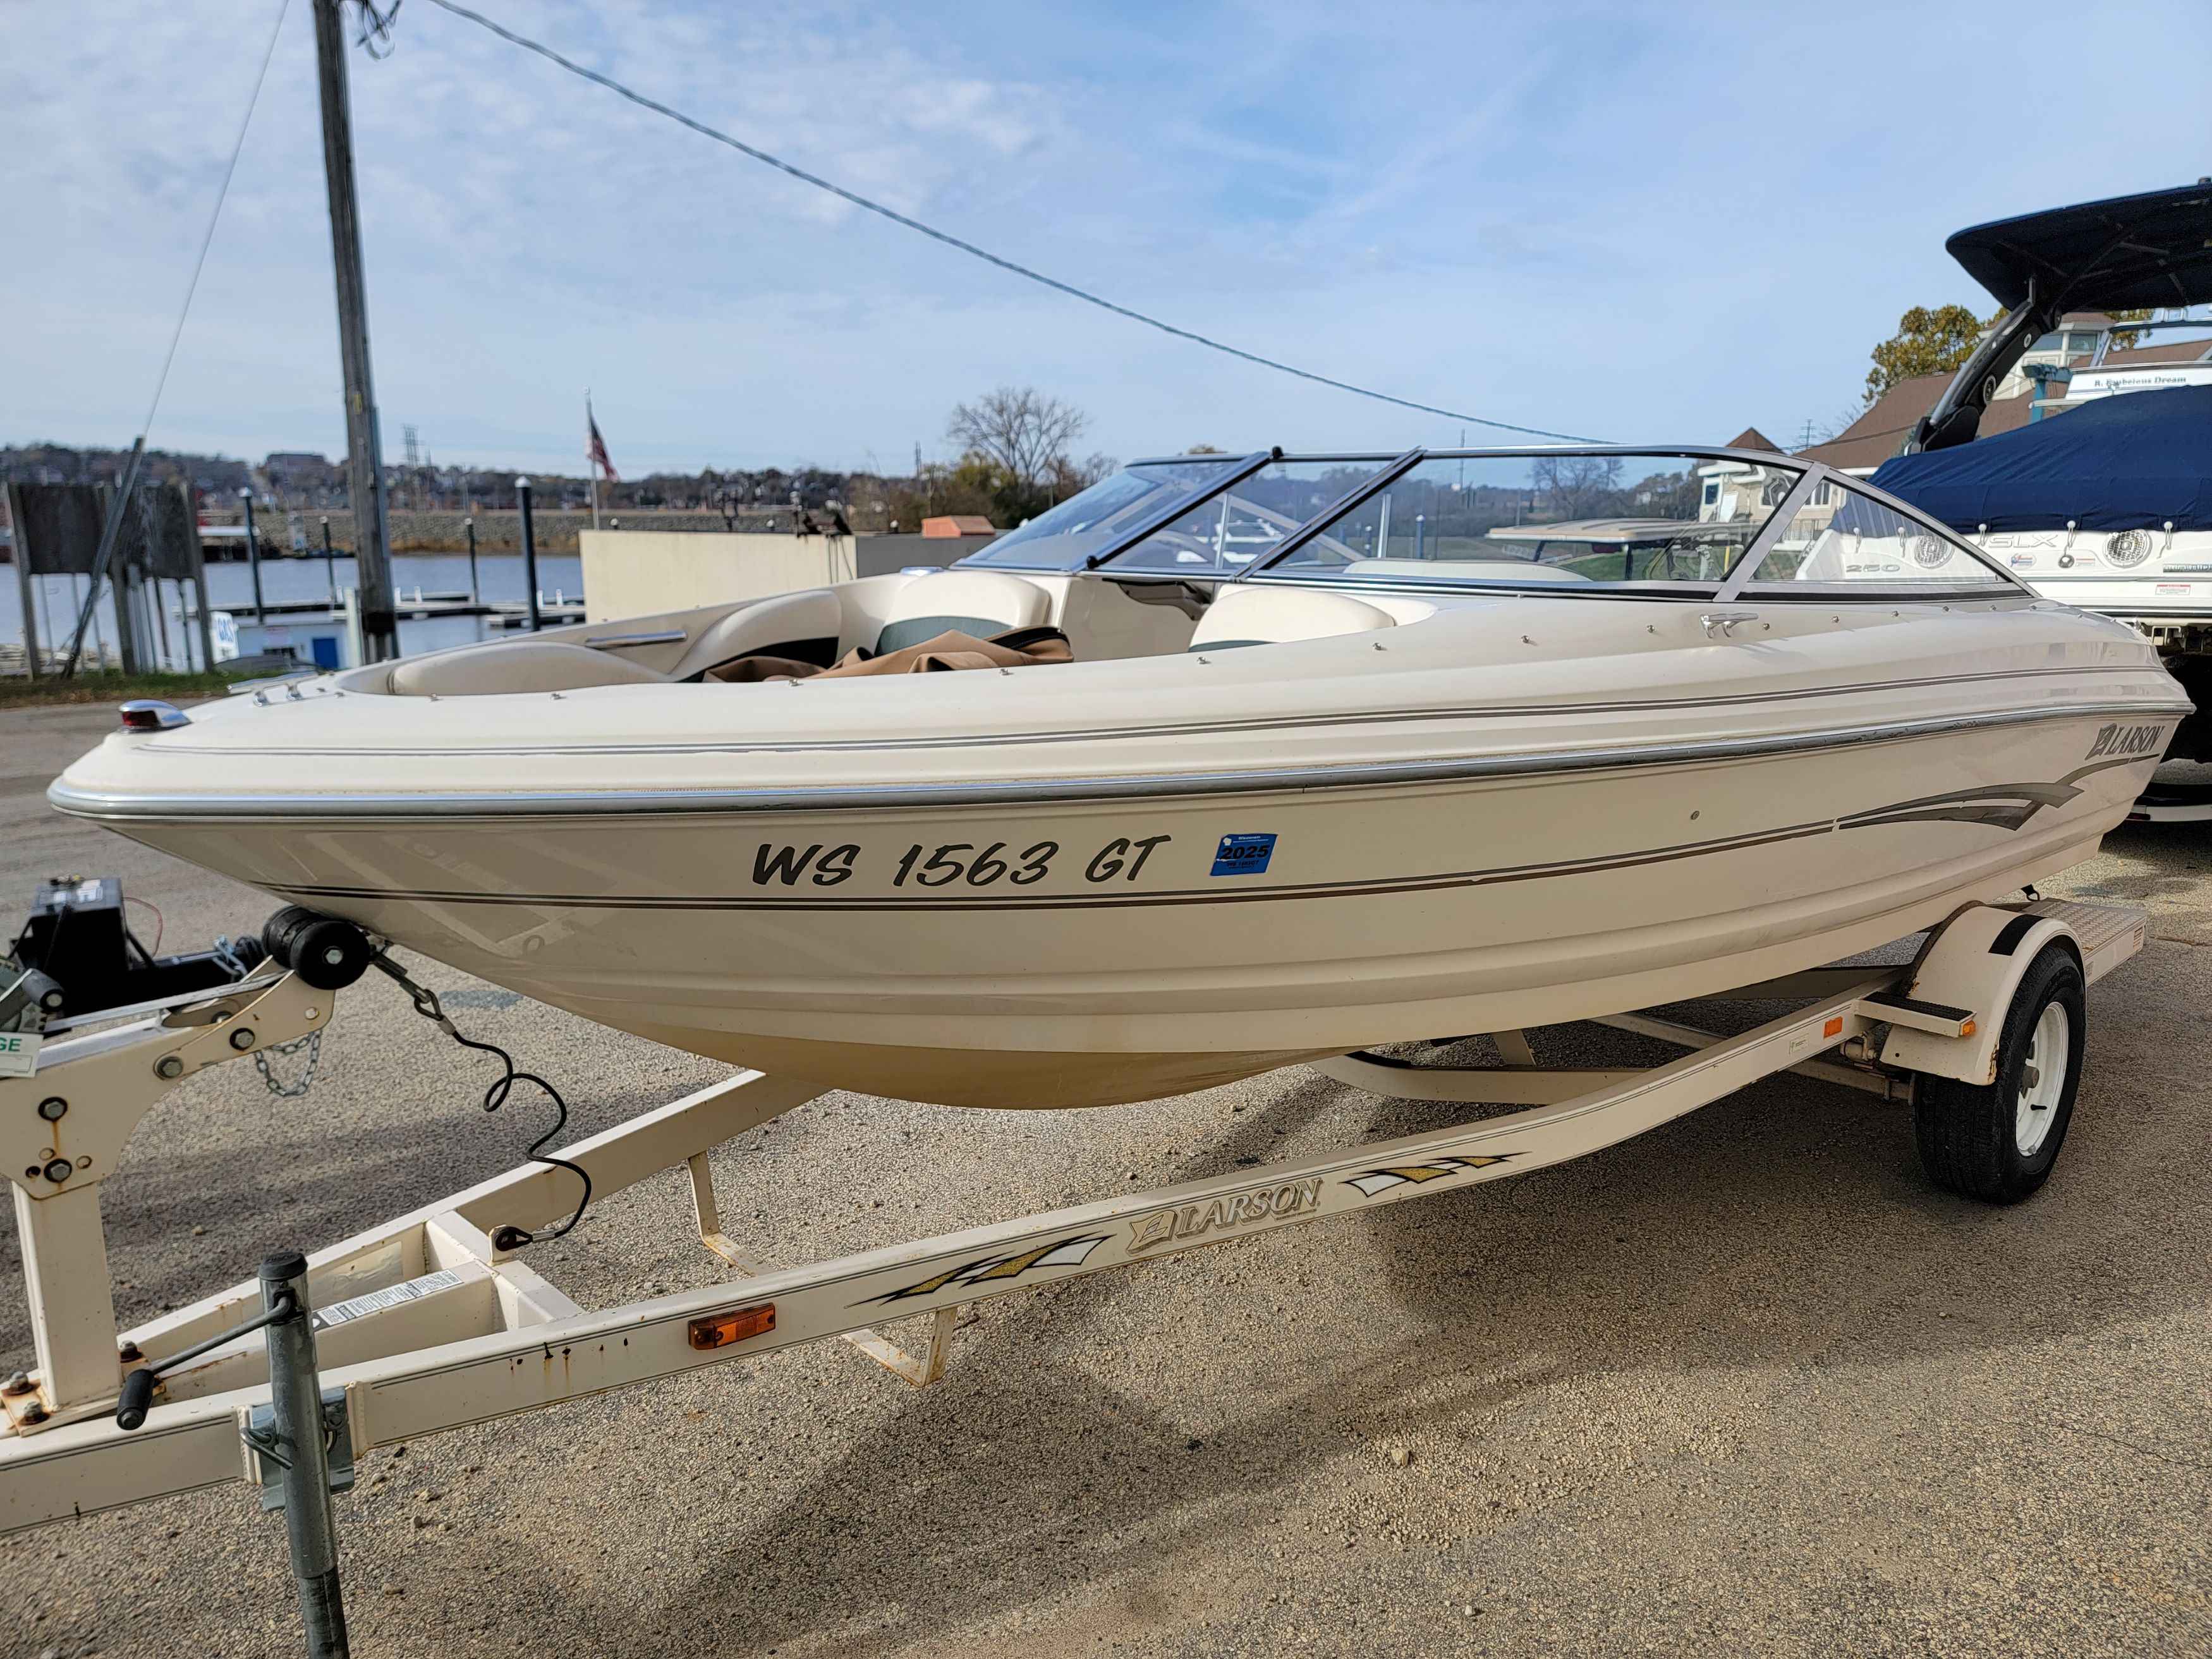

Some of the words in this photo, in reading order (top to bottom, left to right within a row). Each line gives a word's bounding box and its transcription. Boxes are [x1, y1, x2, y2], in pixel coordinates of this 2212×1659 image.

[1988, 533, 2058, 548] SLX
[2104, 726, 2165, 755] LARSON
[752, 844, 861, 886] WS
[893, 841, 1060, 887] 1563
[1085, 834, 1172, 883] GT
[1220, 844, 1270, 860] 2025
[1176, 1177, 1324, 1239] LARSON
